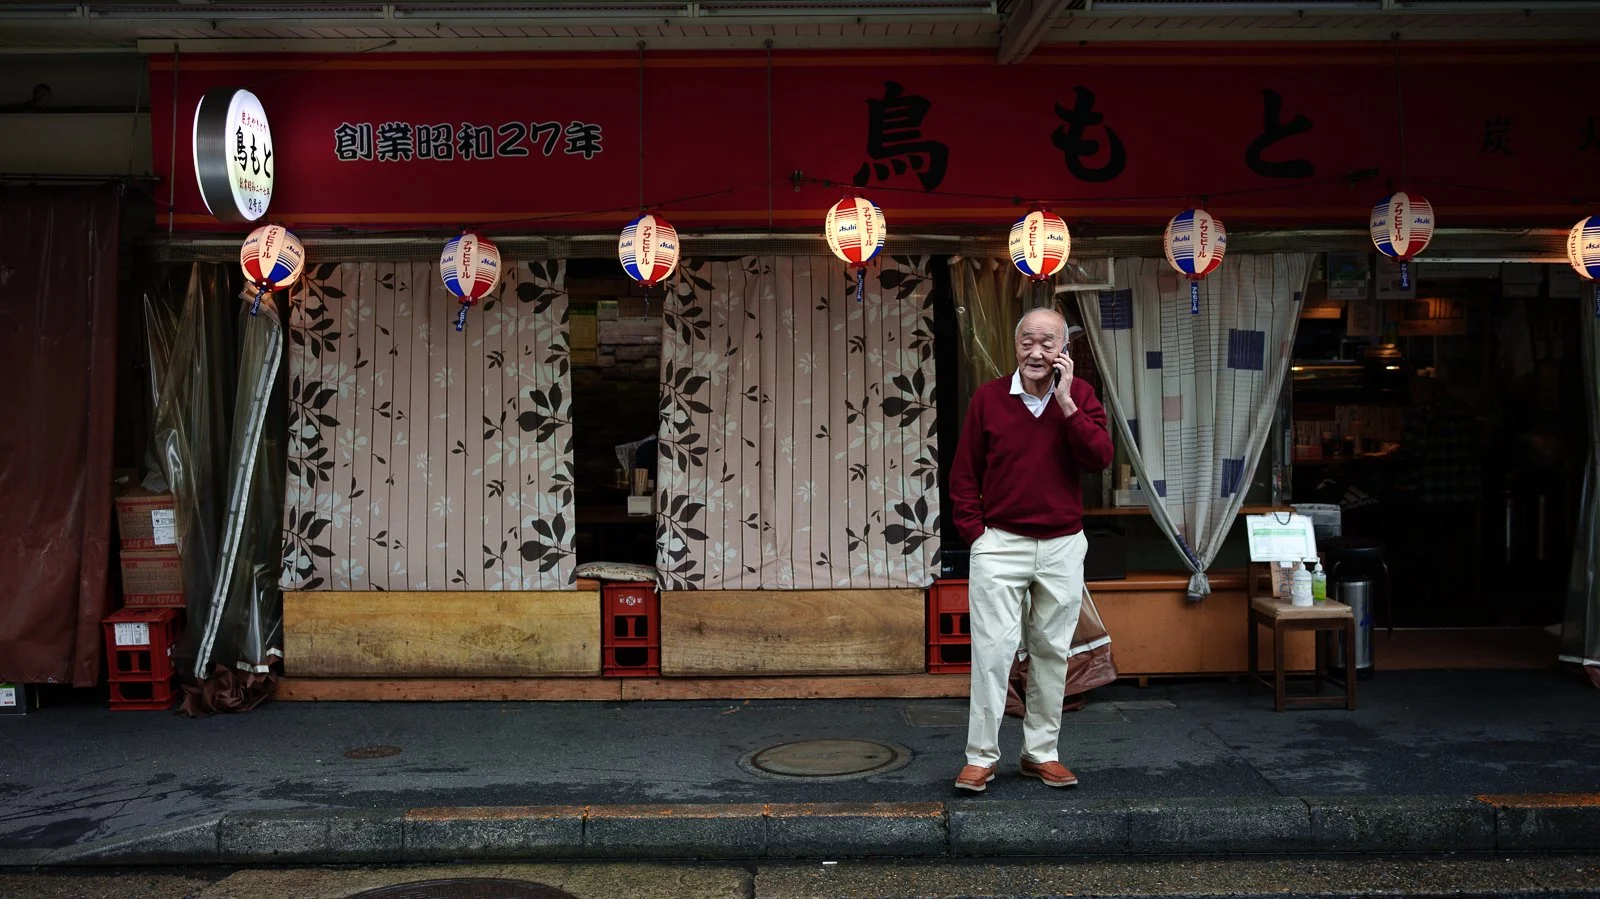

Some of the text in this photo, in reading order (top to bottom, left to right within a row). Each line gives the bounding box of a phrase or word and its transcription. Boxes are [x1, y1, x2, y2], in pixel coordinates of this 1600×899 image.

[233, 124, 272, 179] 鳥もと
[333, 121, 603, 162] 創業昭和27年
[853, 81, 1314, 192] 鳥もと
[248, 197, 263, 214] 2号店
[1393, 201, 1405, 242] アサヒビール
[641, 225, 652, 265] アサヒビール
[862, 206, 874, 247] アサヒビール
[1028, 219, 1039, 259] アサヒビール
[1197, 218, 1208, 258] アサヒビール
[462, 239, 473, 279] アサヒビール
